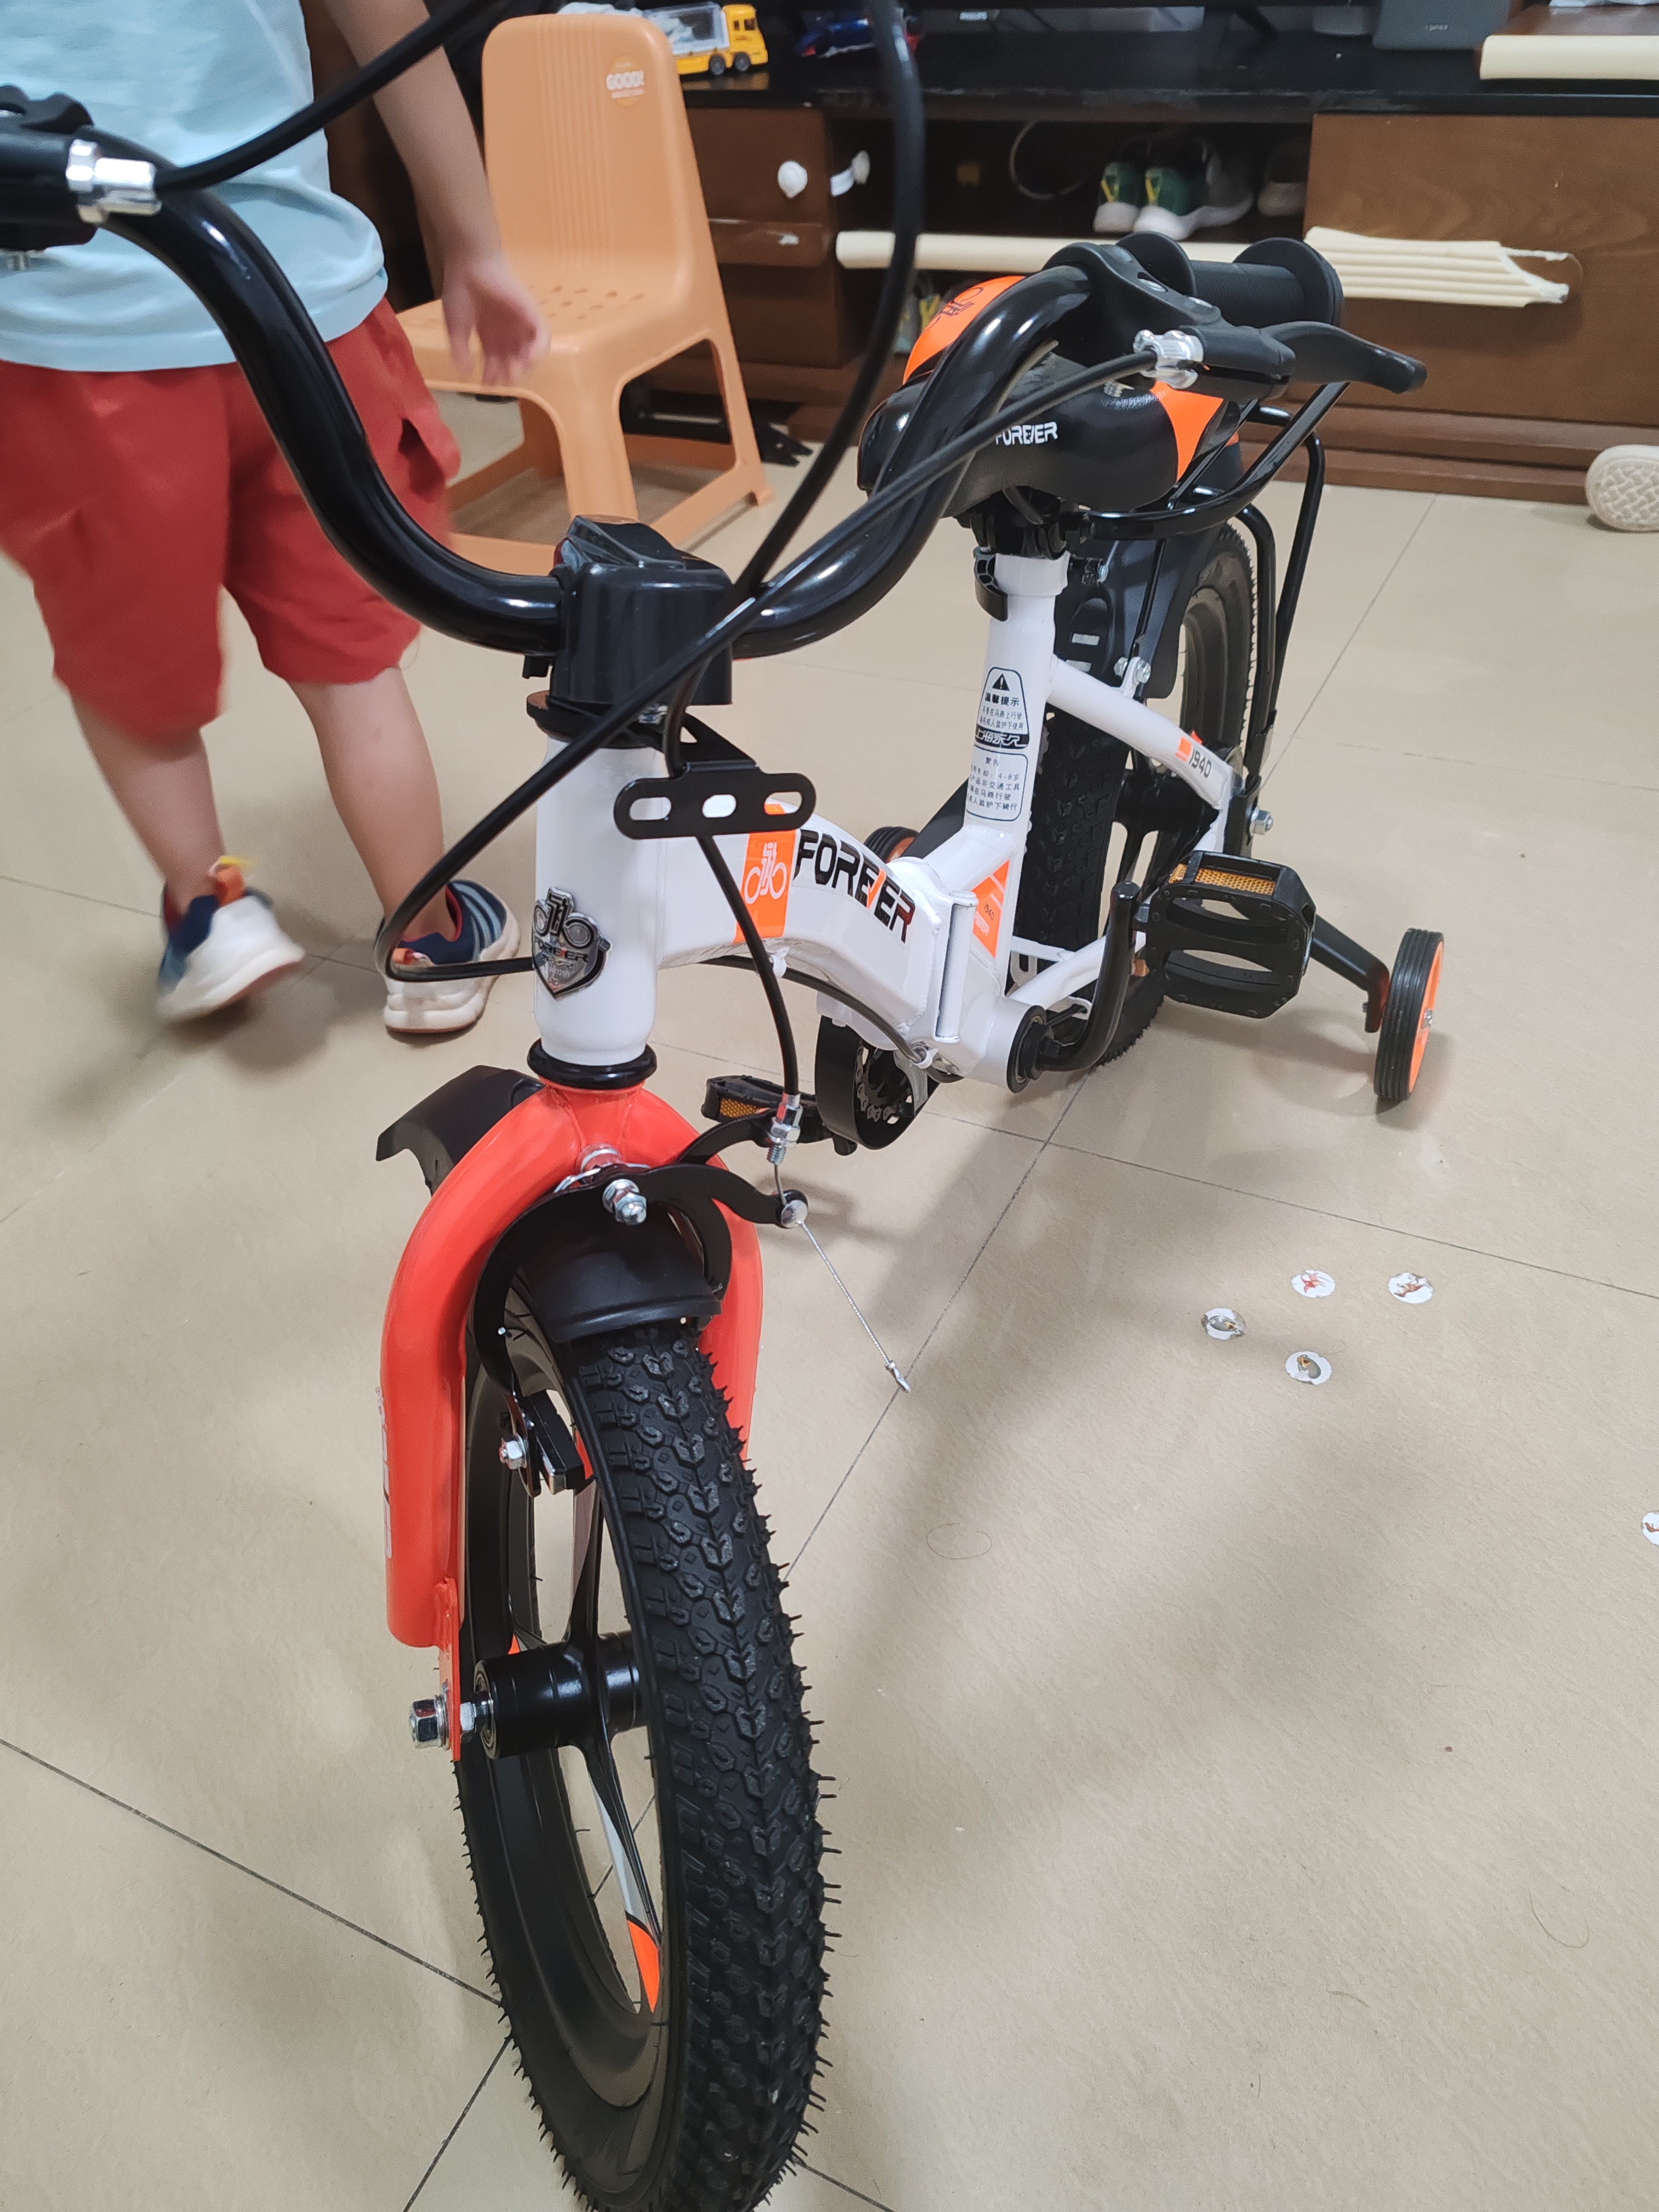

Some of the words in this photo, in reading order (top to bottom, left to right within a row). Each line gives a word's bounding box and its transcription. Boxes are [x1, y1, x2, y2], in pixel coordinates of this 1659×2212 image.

[985, 692, 1019, 706] 温馨提示
[985, 757, 999, 766] 警告
[1188, 747, 1212, 778] 1940
[792, 828, 915, 944] FOREVER
[984, 902, 994, 920] 1940
